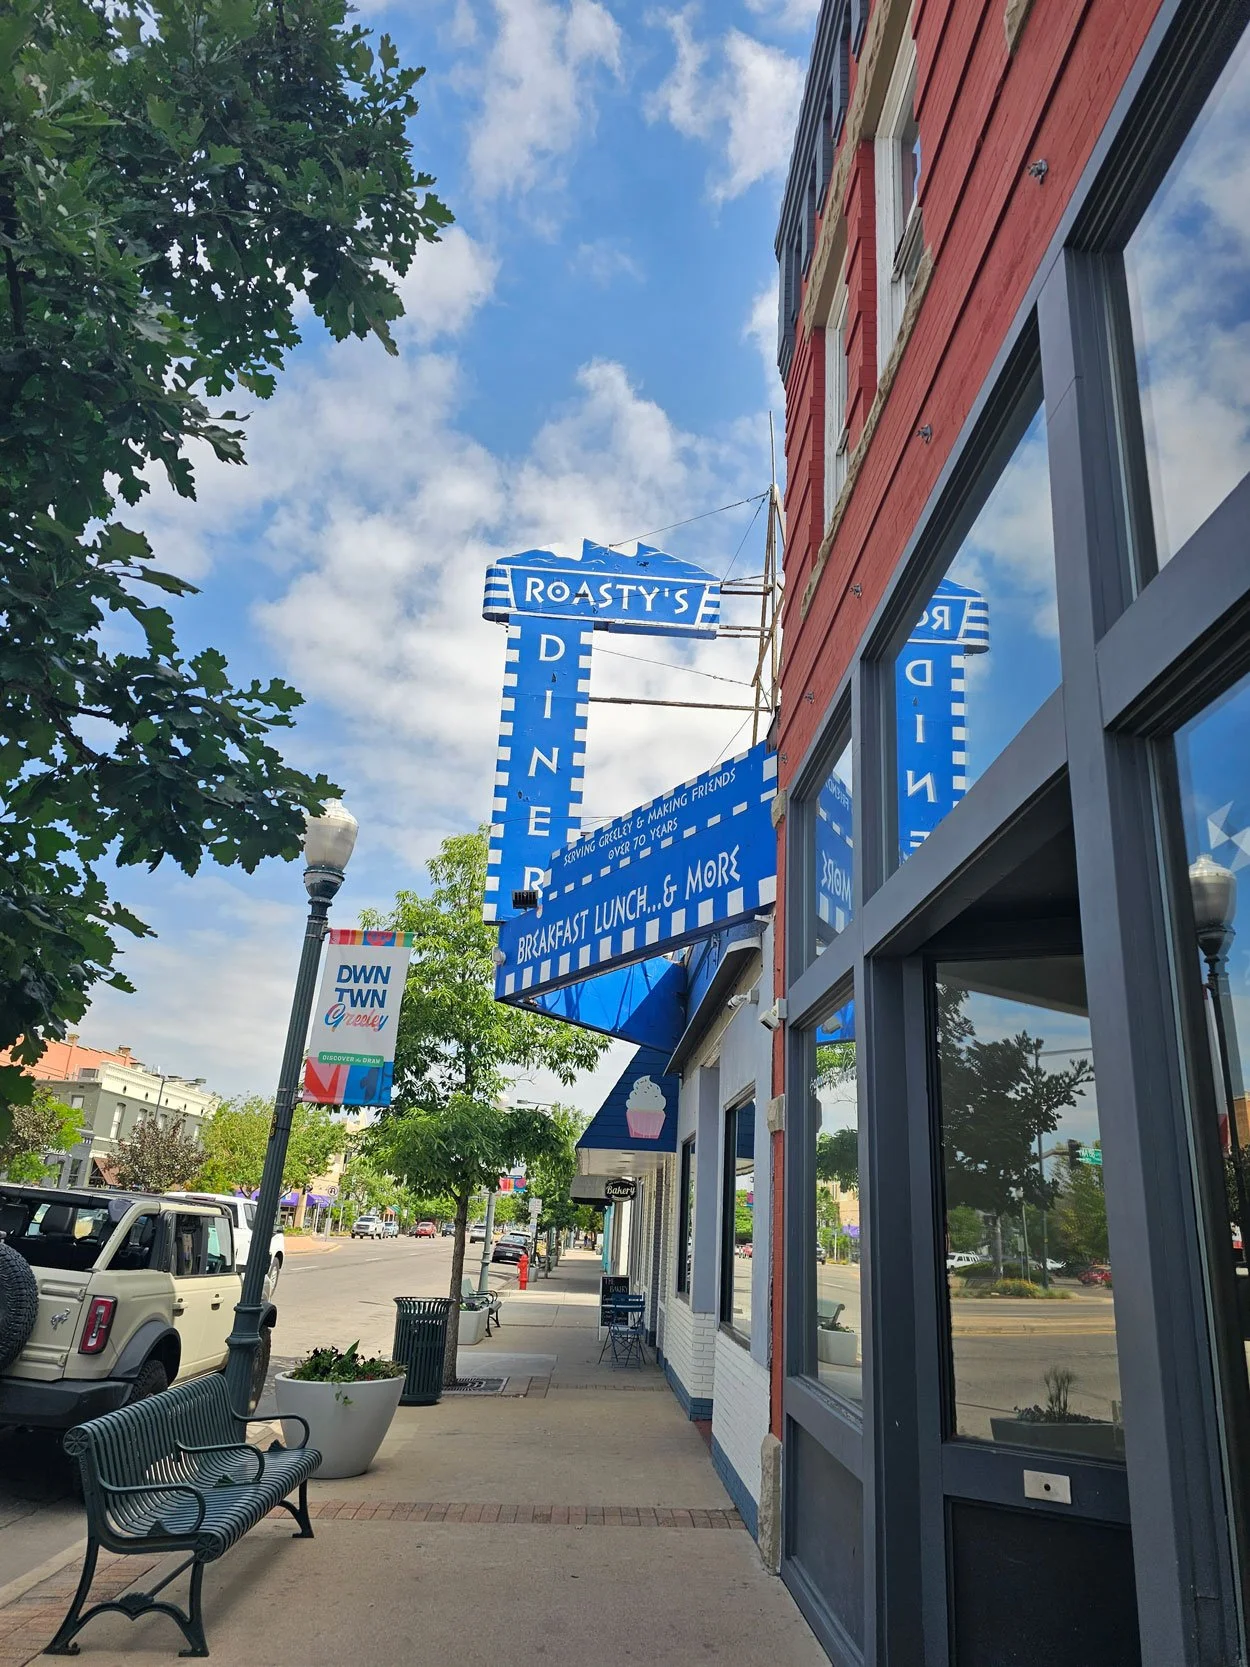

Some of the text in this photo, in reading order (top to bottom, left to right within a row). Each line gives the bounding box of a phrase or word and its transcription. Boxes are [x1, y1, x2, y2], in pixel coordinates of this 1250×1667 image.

[525, 577, 689, 614] ROASTY'S
[564, 767, 736, 867] SERVING GREELEY & MAKING FRIENDS
[608, 817, 678, 860] OVER 70 YEARS
[517, 909, 589, 965] BREAKFAST
[685, 844, 741, 901] MORE
[336, 964, 391, 984] DWN
[334, 988, 387, 1008] TWN
[324, 1002, 389, 1032] Greeley
[322, 1054, 355, 1062] DISCOVER
[362, 1057, 380, 1065] DRAW
[606, 1185, 636, 1196] Bakery
